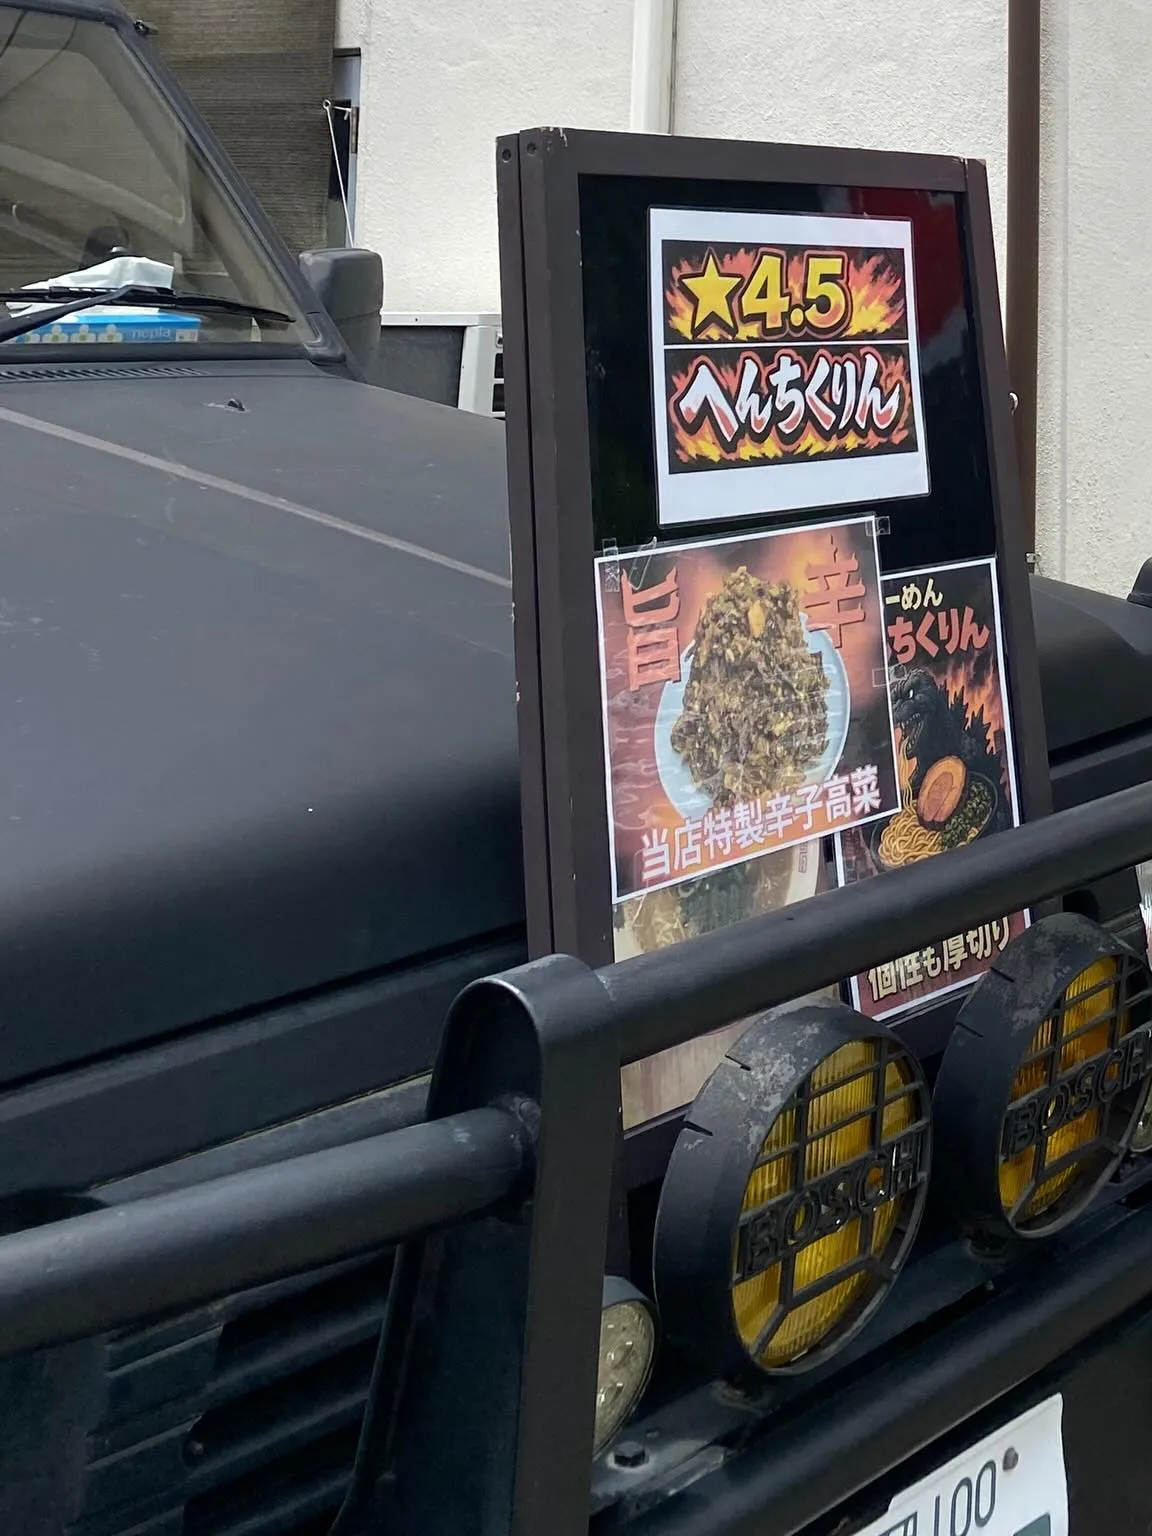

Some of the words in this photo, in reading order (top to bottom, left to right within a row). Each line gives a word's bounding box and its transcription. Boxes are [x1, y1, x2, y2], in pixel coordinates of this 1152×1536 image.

[677, 350, 902, 443] へんちくりん
[620, 566, 682, 692] 旨
[800, 547, 868, 649] 辛
[886, 605, 990, 664] ちくりん
[640, 763, 883, 883] 当店特製辛子高菜
[867, 915, 1011, 1002] 個性も厚切り
[736, 1129, 926, 1279] BOSCH
